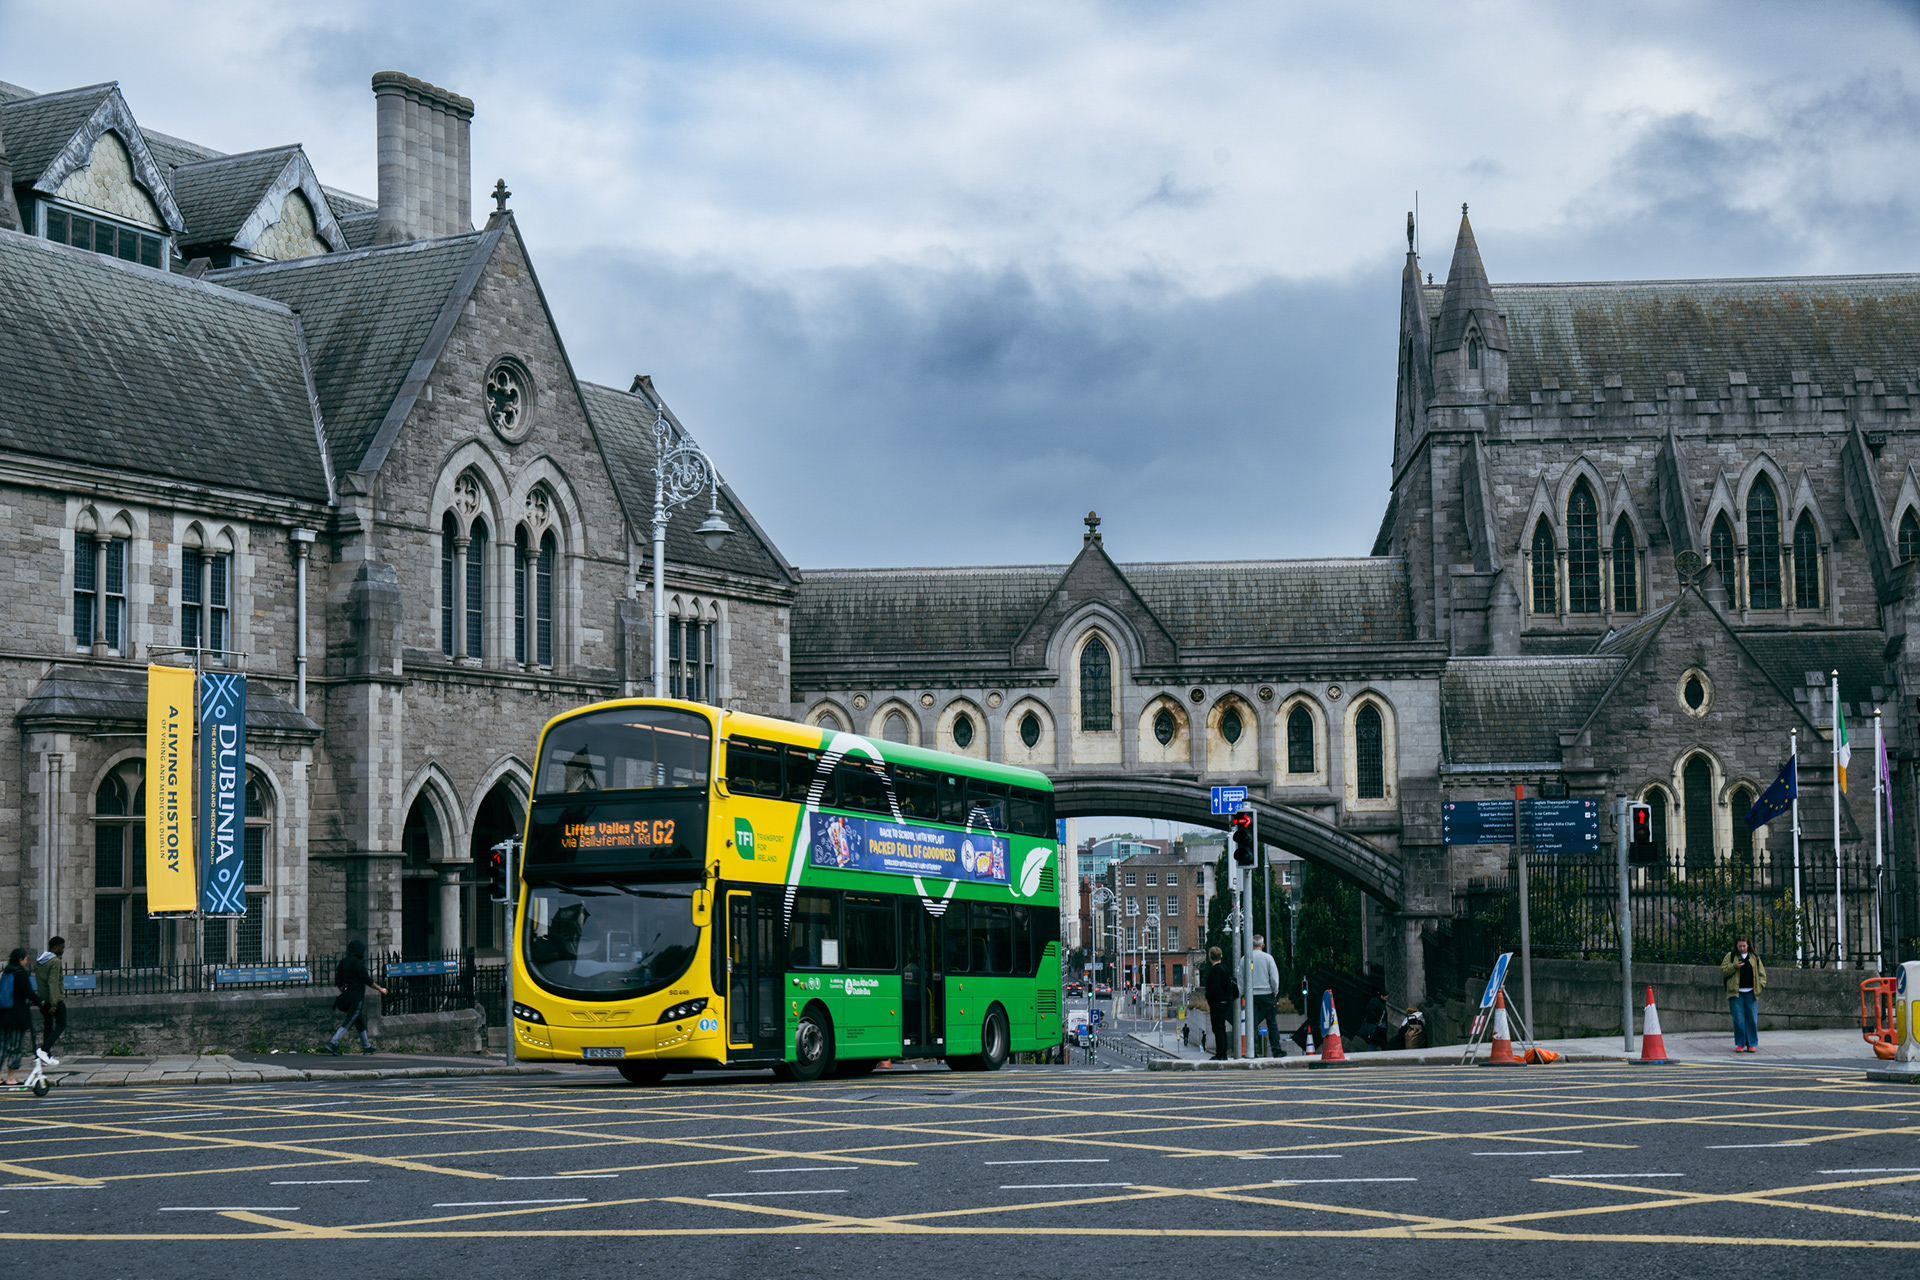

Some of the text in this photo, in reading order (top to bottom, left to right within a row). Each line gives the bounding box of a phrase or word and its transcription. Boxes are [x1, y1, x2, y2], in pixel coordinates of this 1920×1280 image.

[161, 720, 166, 730] OF
[211, 761, 216, 769] OF
[167, 705, 179, 873] A LIVING HISTORY
[216, 724, 236, 864] DUBLINIA
[565, 821, 648, 836] Liffey Valley SC
[652, 820, 675, 844] G2
[880, 827, 892, 838] BACK
[892, 828, 898, 838] TO
[898, 830, 915, 841] SCHOOL
[562, 833, 651, 848] via Ballyfermot Rd
[736, 830, 753, 847] TFI
[756, 833, 784, 843] TRANSPORT
[869, 839, 896, 855] PACKED
[896, 842, 913, 858] FULL
[913, 844, 922, 859] OF
[923, 846, 956, 862] GOODNESS
